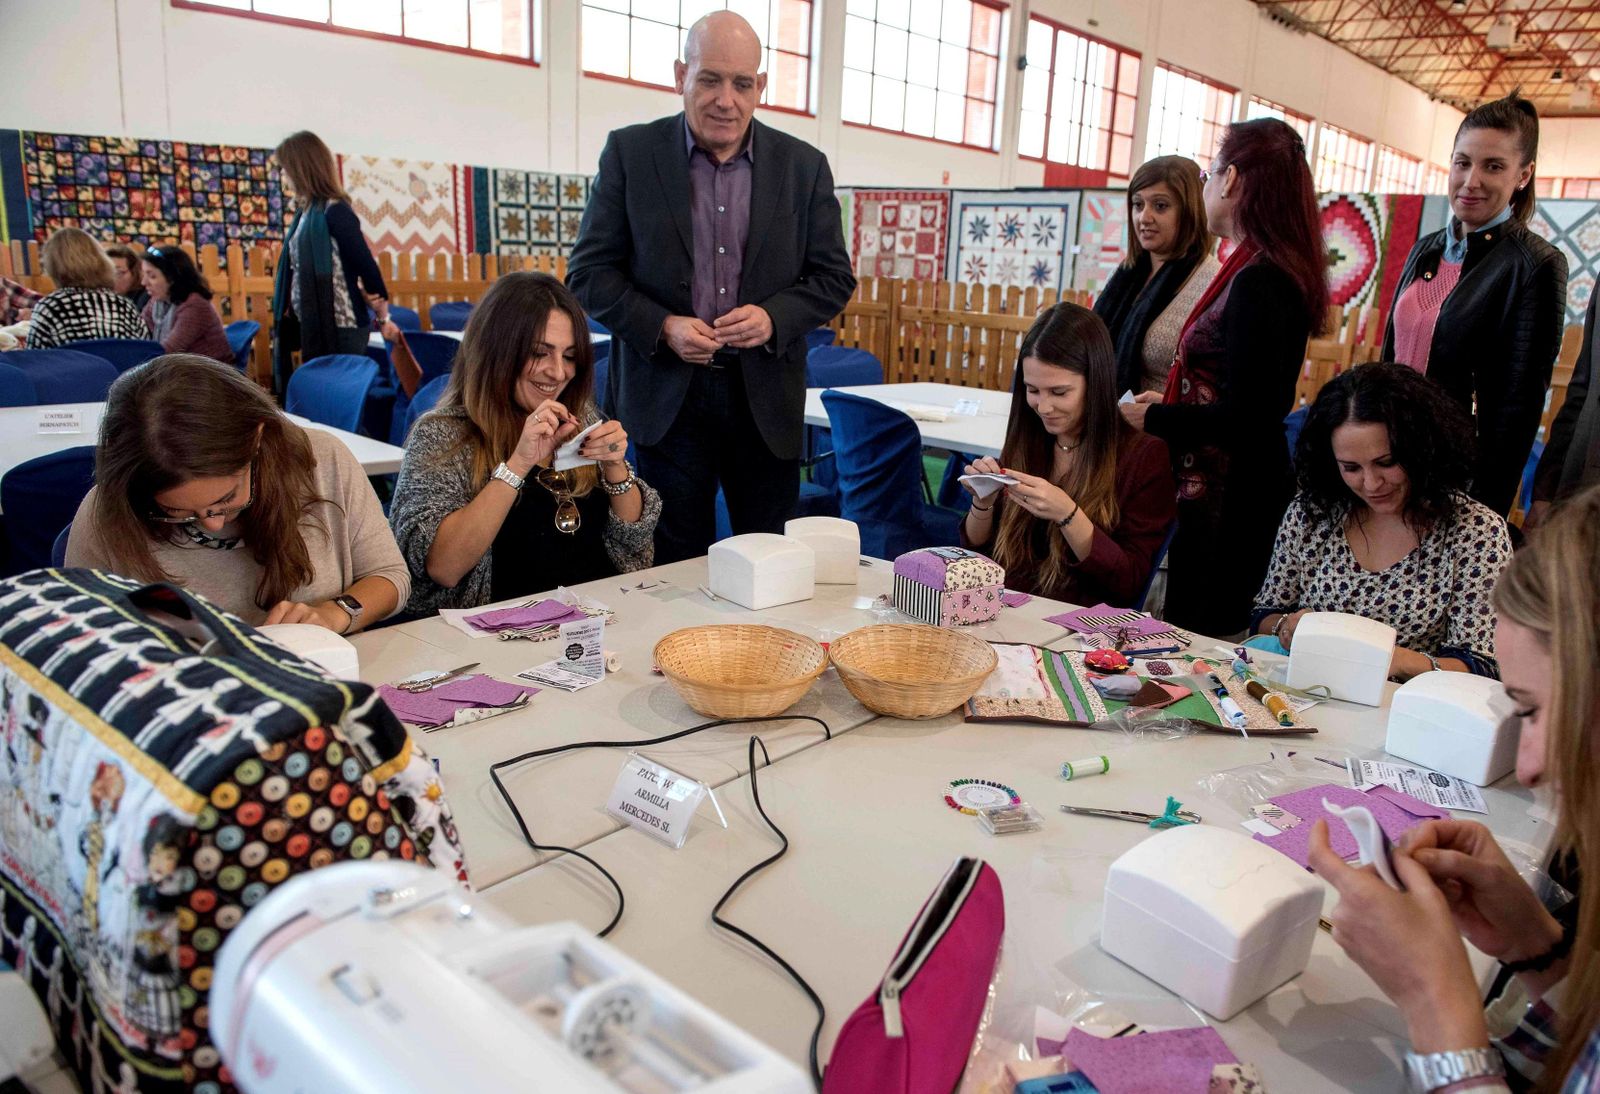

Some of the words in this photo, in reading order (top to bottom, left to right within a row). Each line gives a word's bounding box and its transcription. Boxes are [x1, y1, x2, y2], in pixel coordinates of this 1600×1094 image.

[635, 787, 670, 811] ARMILLA
[619, 800, 661, 828] MERCEDES
[660, 821, 670, 833] SL
